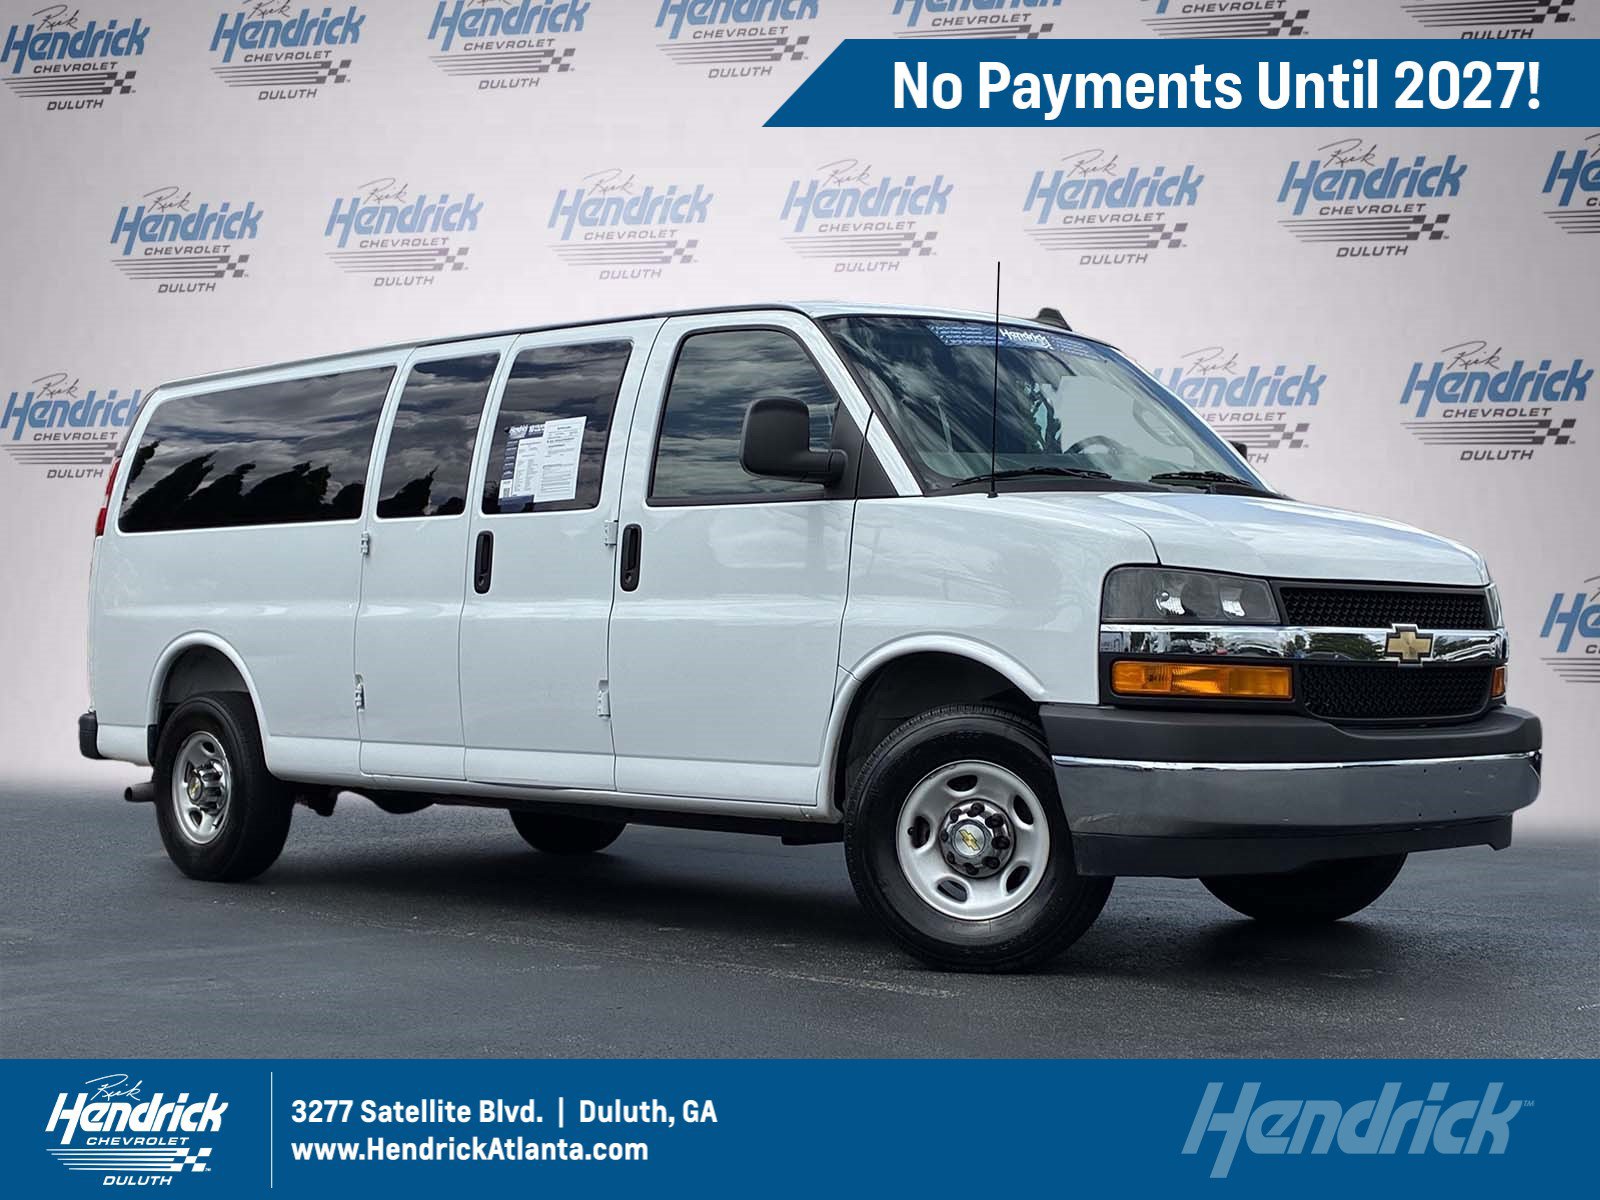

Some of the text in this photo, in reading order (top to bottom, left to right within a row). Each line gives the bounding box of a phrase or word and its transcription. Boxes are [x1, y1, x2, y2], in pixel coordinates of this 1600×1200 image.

[1182, 0, 1286, 14] CHEVROLET
[427, 0, 591, 51] Hendrick
[931, 13, 1032, 27] CHEVROLET
[209, 6, 366, 63] Hendrick
[692, 26, 788, 39] CHEVROLET
[0, 18, 150, 74] Hendrick
[463, 38, 556, 51] CHEVROLET
[244, 50, 332, 63] CHEVROLET
[33, 62, 118, 74] CHEVROLET
[708, 66, 773, 79] DULUTH
[478, 77, 540, 90] DULUTH
[258, 88, 317, 100] DULUTH
[47, 99, 104, 111] DULUTH
[1277, 155, 1468, 216] Hendrick
[1023, 165, 1205, 224] Hendrick
[780, 175, 954, 232] Hendrick
[1319, 203, 1426, 215] CHEVROLET
[547, 184, 714, 241] Hendrick
[1062, 212, 1165, 225] CHEVROLET
[324, 193, 484, 248] Hendrick
[818, 221, 916, 232] CHEVROLET
[110, 201, 264, 256] Hendrick
[584, 229, 679, 241] CHEVROLET
[359, 237, 449, 248] CHEVROLET
[144, 245, 231, 256] CHEVROLET
[1336, 245, 1409, 257] DULUTH
[1079, 253, 1148, 265] DULUTH
[834, 261, 900, 273] DULUTH
[599, 268, 662, 280] DULUTH
[158, 282, 216, 293] DULUTH
[374, 276, 434, 287] DULUTH
[1400, 359, 1594, 417] Hendrick
[1202, 412, 1286, 422] EVROLET
[1442, 407, 1552, 418] CHEVROLET
[33, 432, 118, 441] CHEVROLET
[1460, 449, 1534, 461] DULUTH
[47, 469, 103, 478] DULUTH
